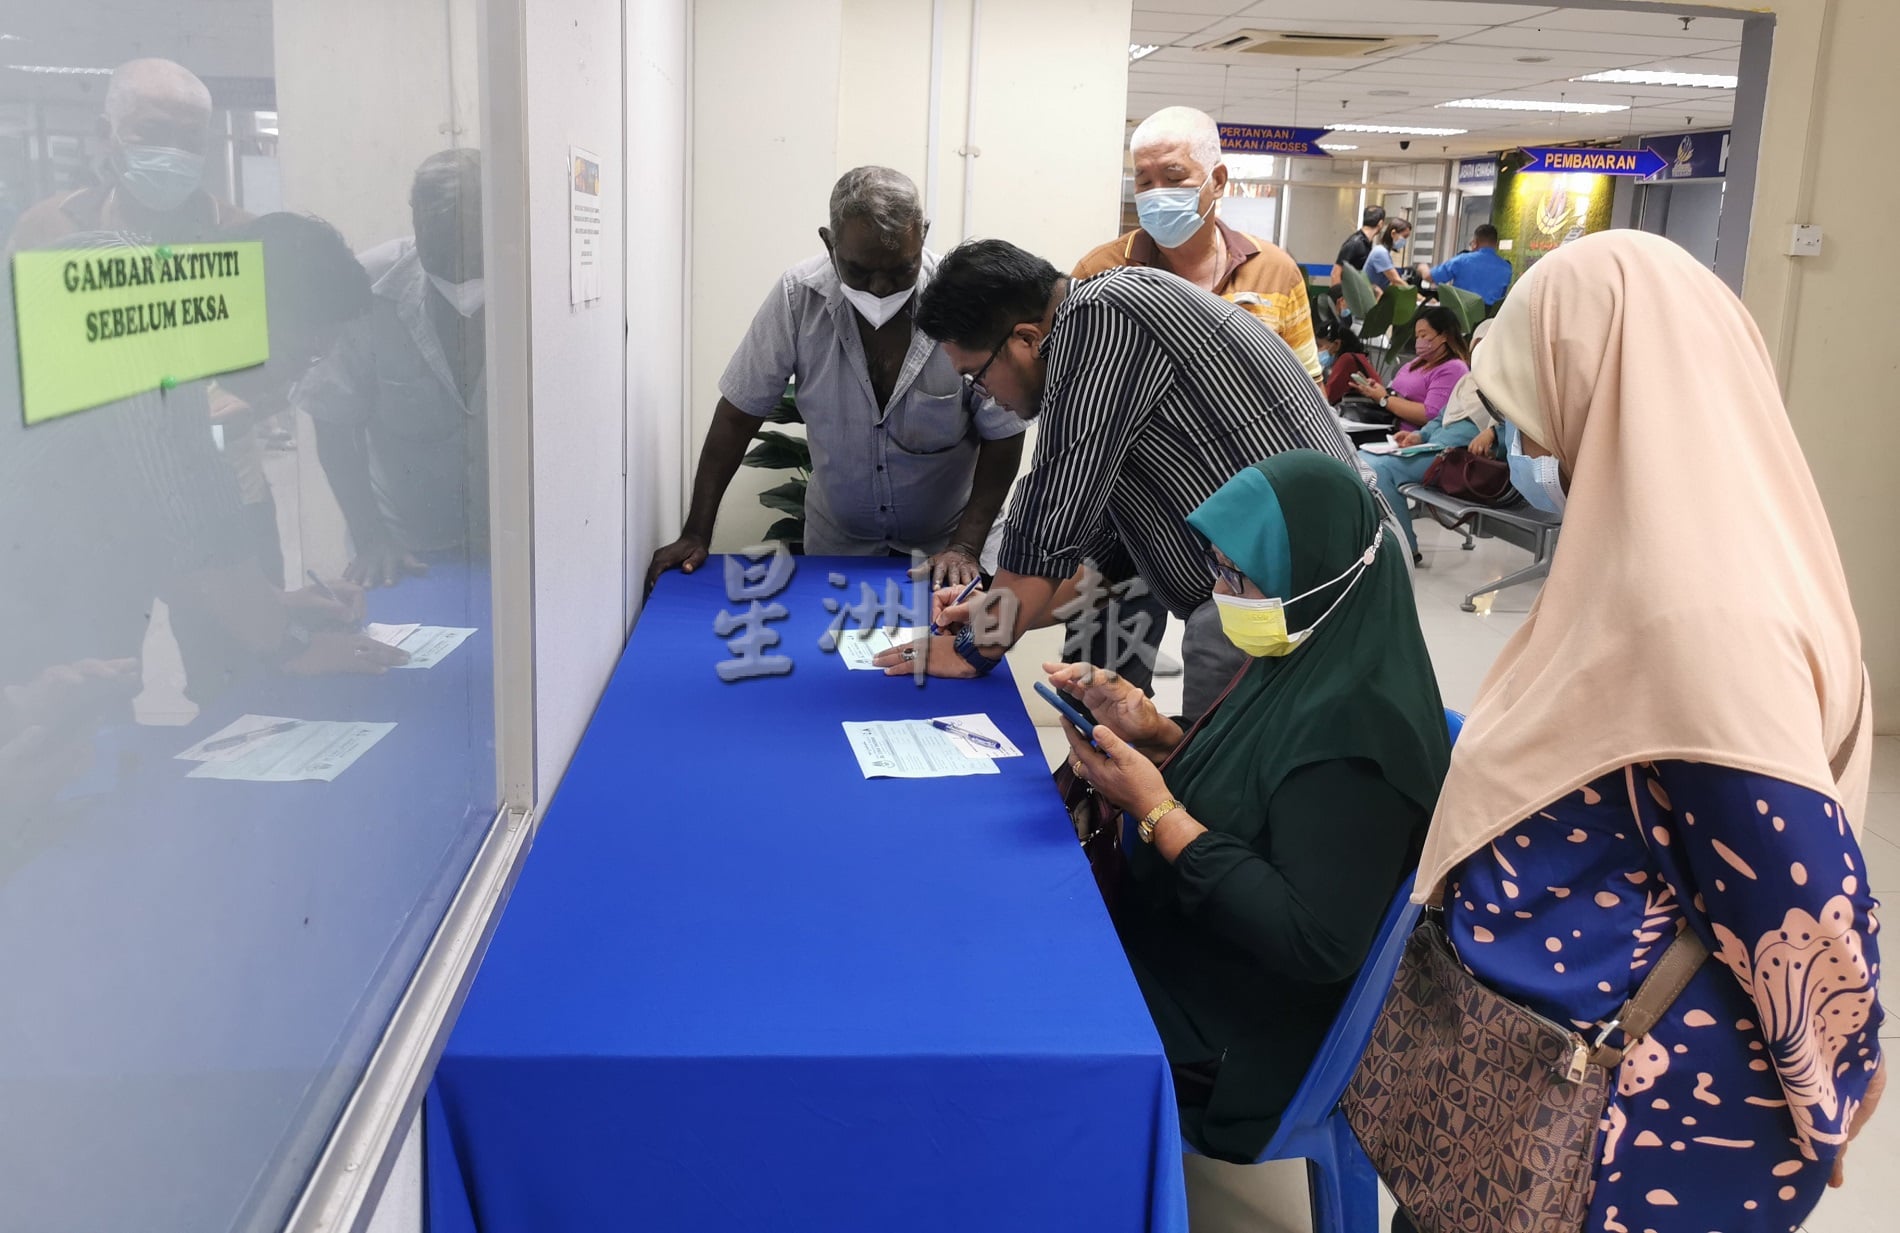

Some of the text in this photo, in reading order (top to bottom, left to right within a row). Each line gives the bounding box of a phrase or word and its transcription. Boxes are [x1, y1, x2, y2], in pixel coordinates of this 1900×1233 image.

[1220, 127, 1289, 139] PERTANYAAN
[1220, 138, 1258, 149] MAKAN
[1266, 141, 1308, 152] PROSES
[1544, 153, 1637, 170] PEMBAYARAN
[63, 250, 240, 292] GAMBAR AKTIVITI
[86, 294, 229, 343] SEBELUM EKSA
